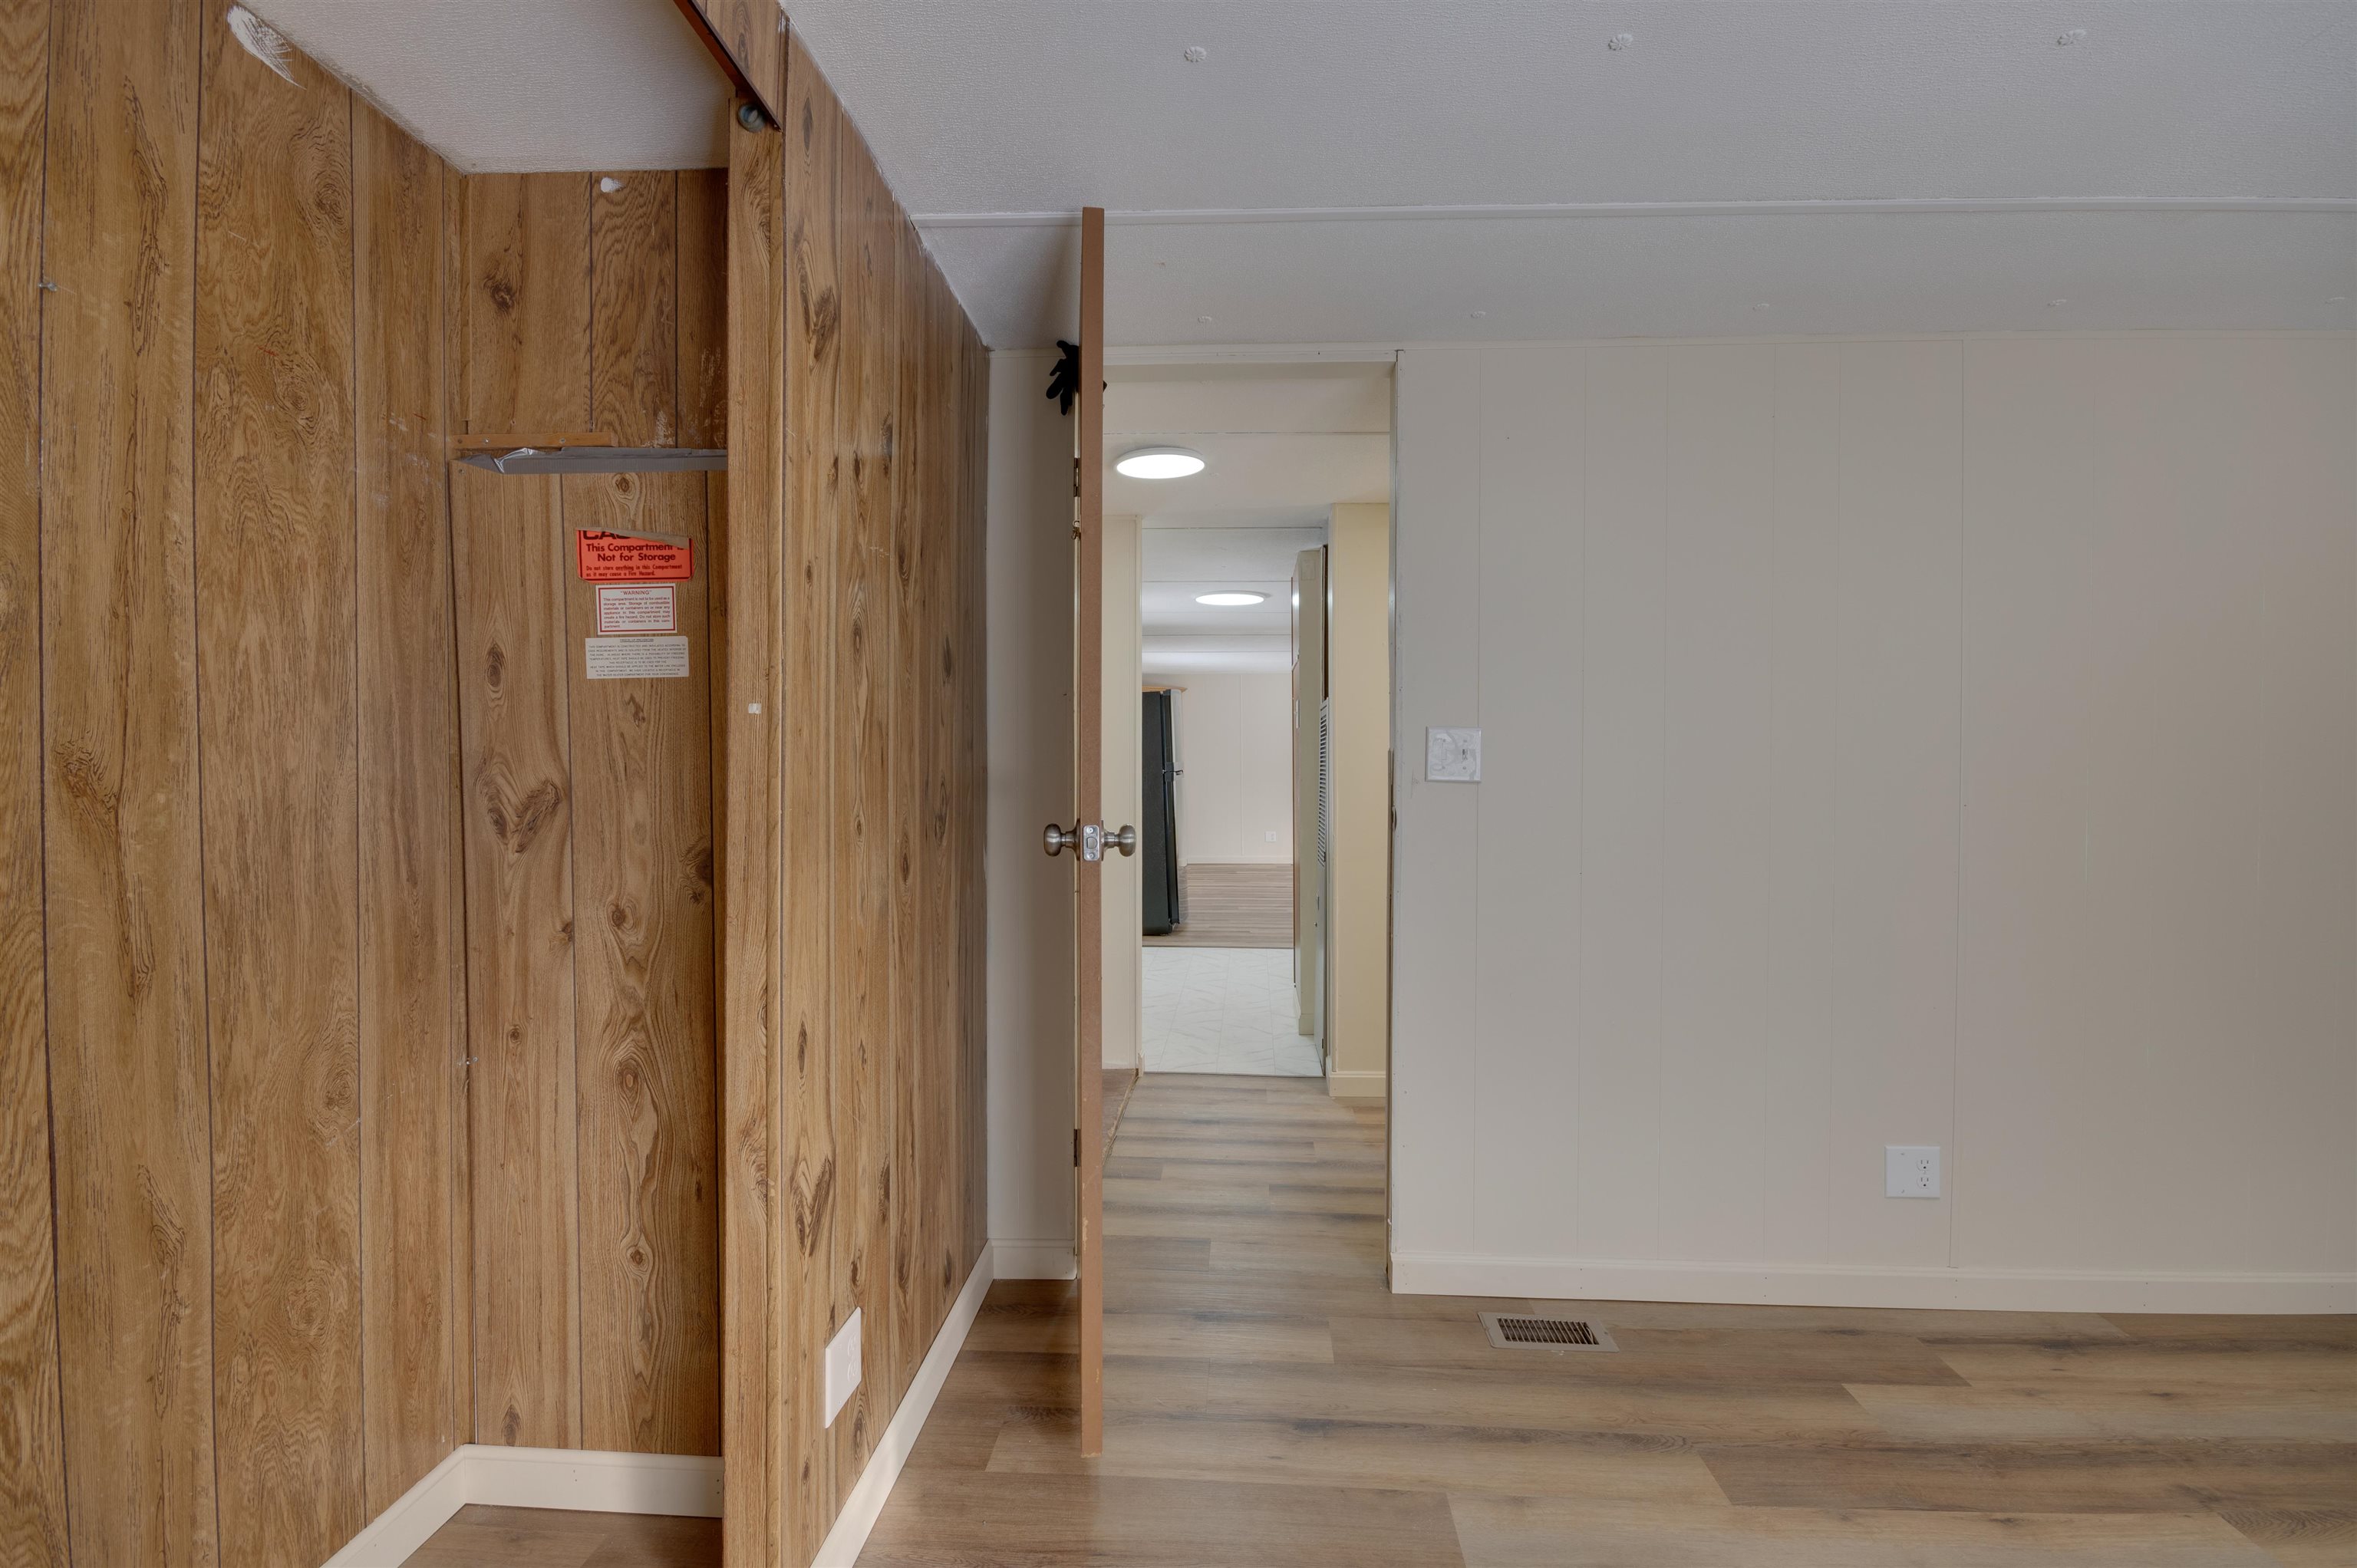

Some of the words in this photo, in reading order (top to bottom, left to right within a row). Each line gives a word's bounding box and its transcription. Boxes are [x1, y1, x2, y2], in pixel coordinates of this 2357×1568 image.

[586, 543, 605, 552] This
[597, 553, 615, 562] Not
[619, 552, 634, 561] for
[638, 552, 676, 562] Storage
